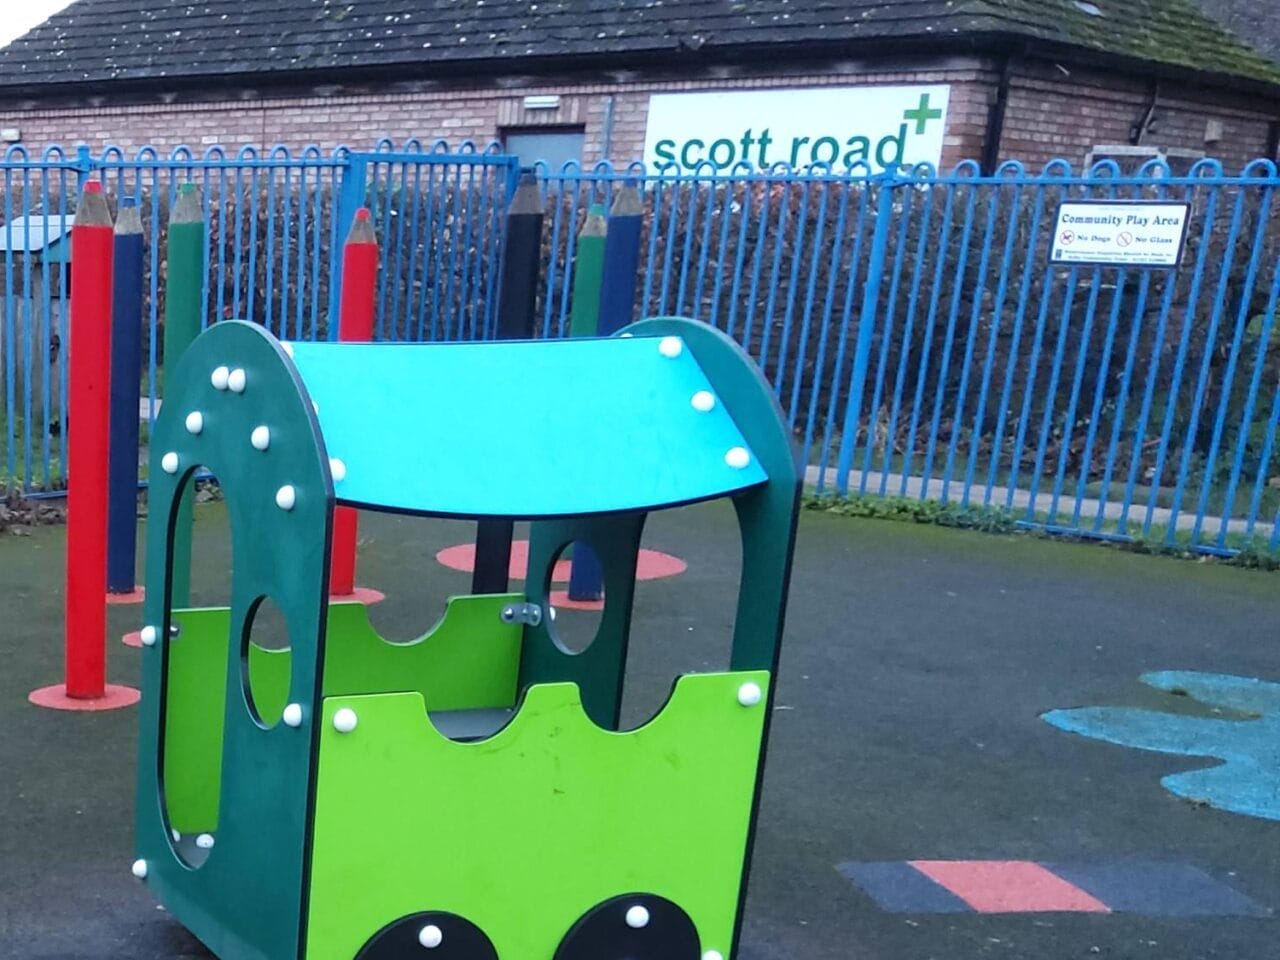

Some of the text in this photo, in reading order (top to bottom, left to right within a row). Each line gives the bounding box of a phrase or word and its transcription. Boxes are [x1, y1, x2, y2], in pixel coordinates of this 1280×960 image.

[652, 122, 908, 171] scott road
[1061, 213, 1180, 228] Community Play Area
[1077, 234, 1111, 243] No Dogs
[1135, 235, 1173, 244] No Glass
